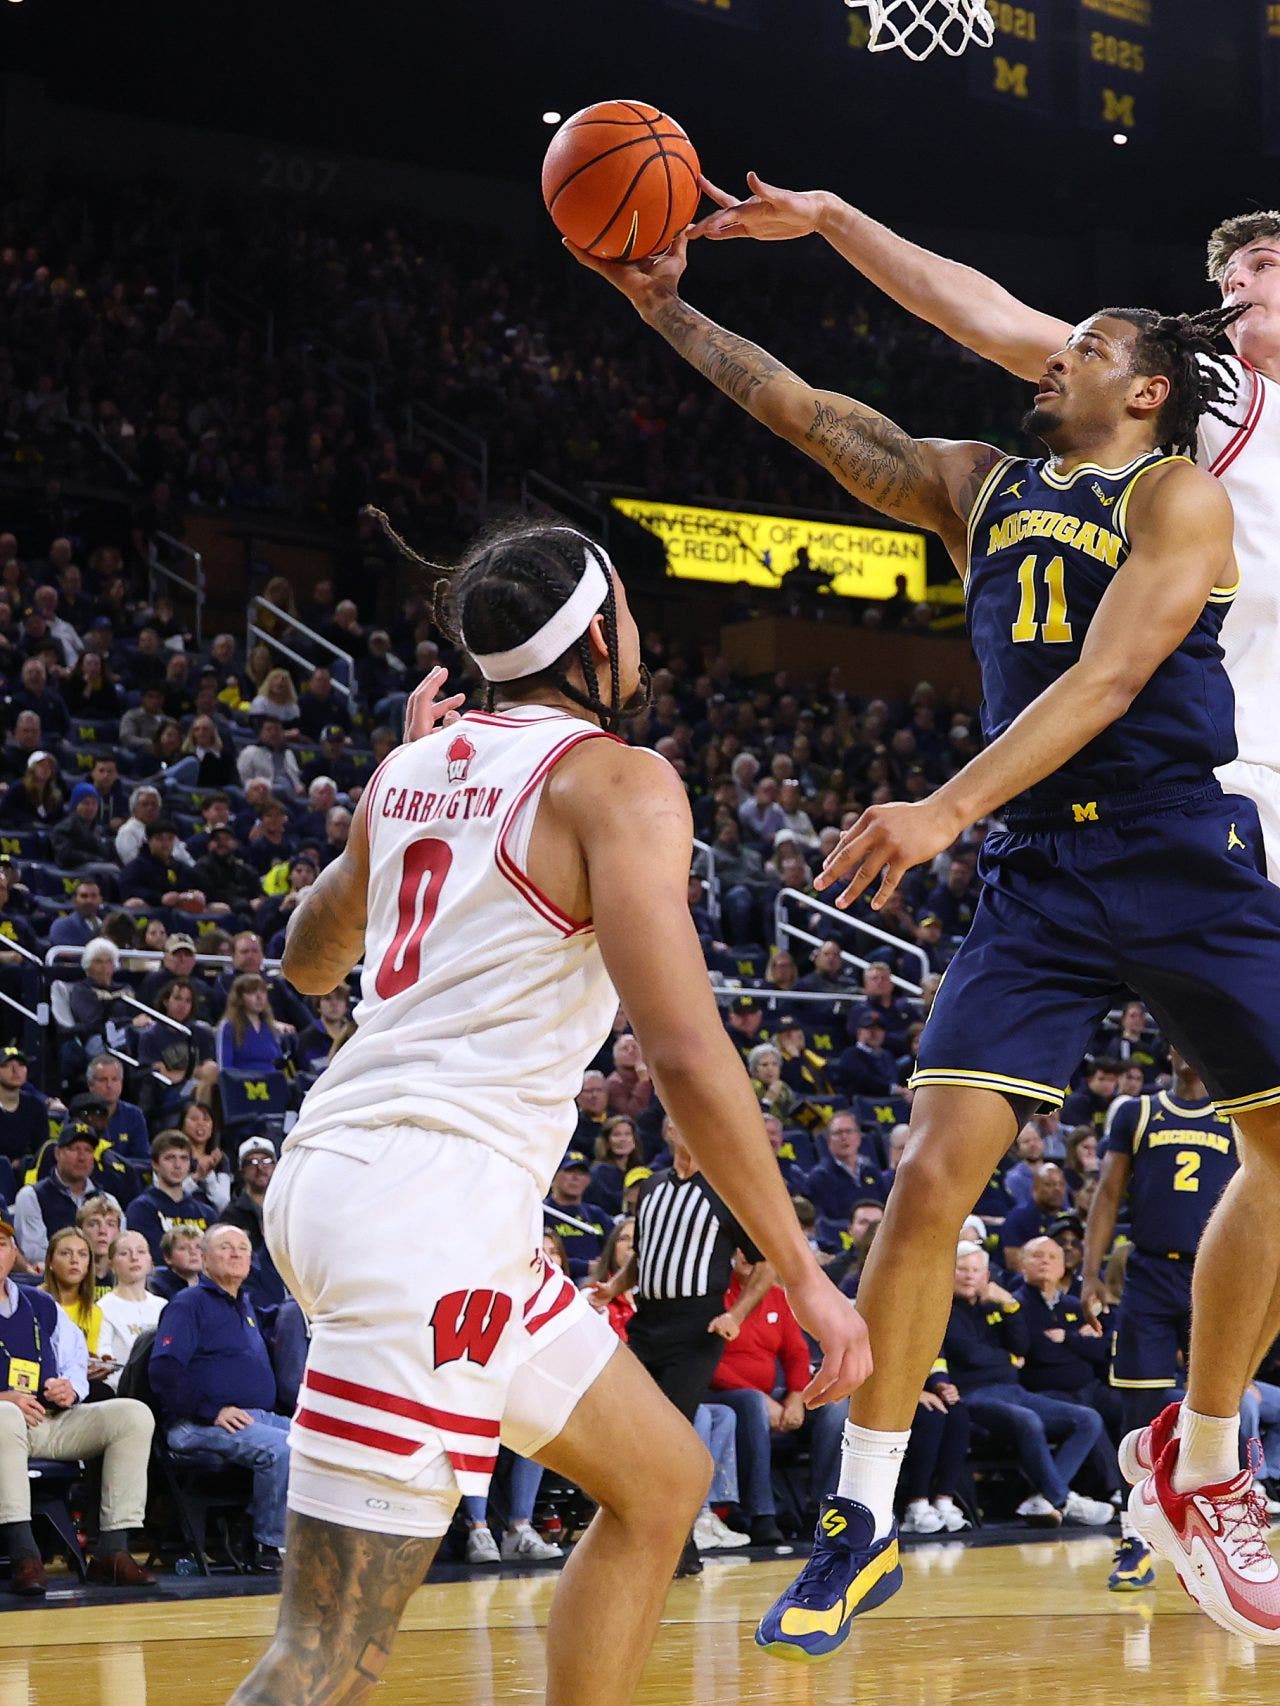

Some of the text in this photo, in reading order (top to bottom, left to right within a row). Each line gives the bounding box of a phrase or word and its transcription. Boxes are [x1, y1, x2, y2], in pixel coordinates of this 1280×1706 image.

[994, 56, 1028, 97] M
[1103, 89, 1135, 126] M
[667, 538, 752, 565] CREDIT
[770, 524, 800, 545] OF
[807, 530, 920, 560] MICHIGAN
[986, 510, 1125, 570] MICHIGAN
[1011, 554, 1073, 643] 11
[1072, 802, 1098, 822] M
[375, 838, 453, 1000] 0
[244, 1081, 270, 1101] M
[75, 1122, 89, 1133] M
[1173, 1150, 1201, 1192] 2
[428, 1288, 514, 1371] W
